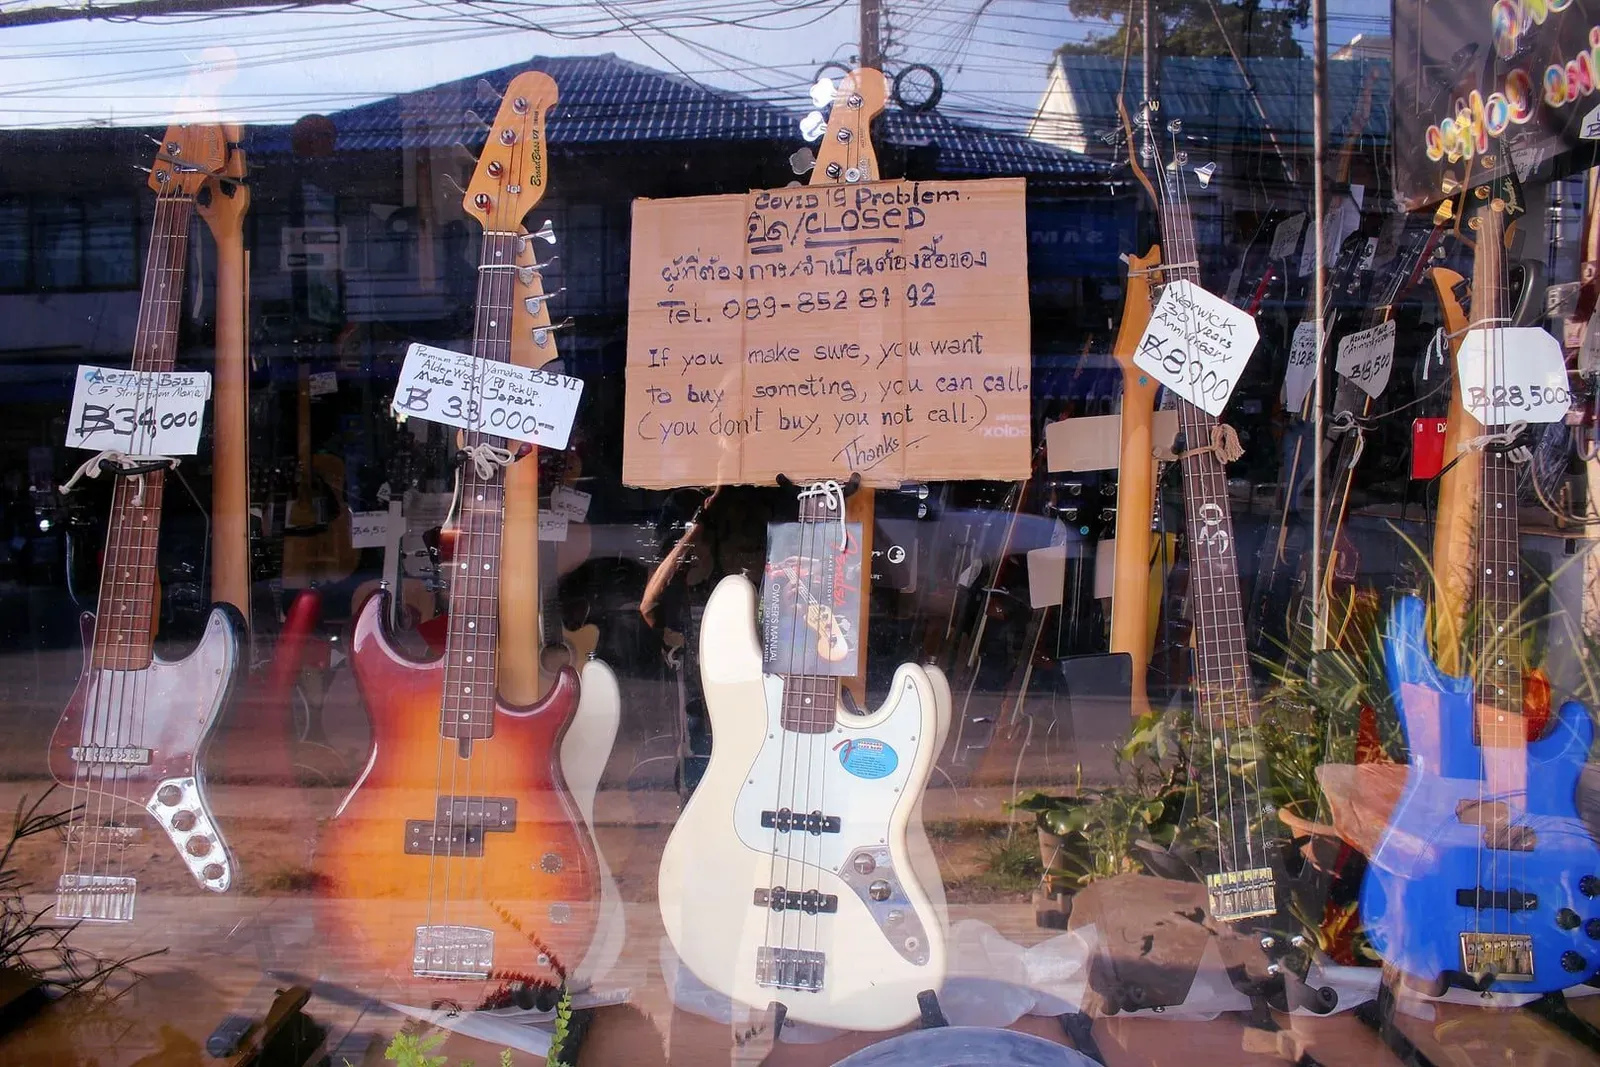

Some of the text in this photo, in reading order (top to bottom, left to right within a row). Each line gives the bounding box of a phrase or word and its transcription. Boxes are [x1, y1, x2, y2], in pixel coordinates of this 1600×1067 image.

[648, 332, 984, 376] If you make sure, you want
[646, 384, 672, 404] to
[687, 384, 725, 412] buy
[878, 379, 922, 404] you
[935, 375, 973, 392] can
[983, 366, 1029, 395] call.
[778, 406, 822, 442] buy,
[834, 410, 868, 435] you
[881, 403, 912, 425] not
[769, 625, 779, 663] MANUAL
